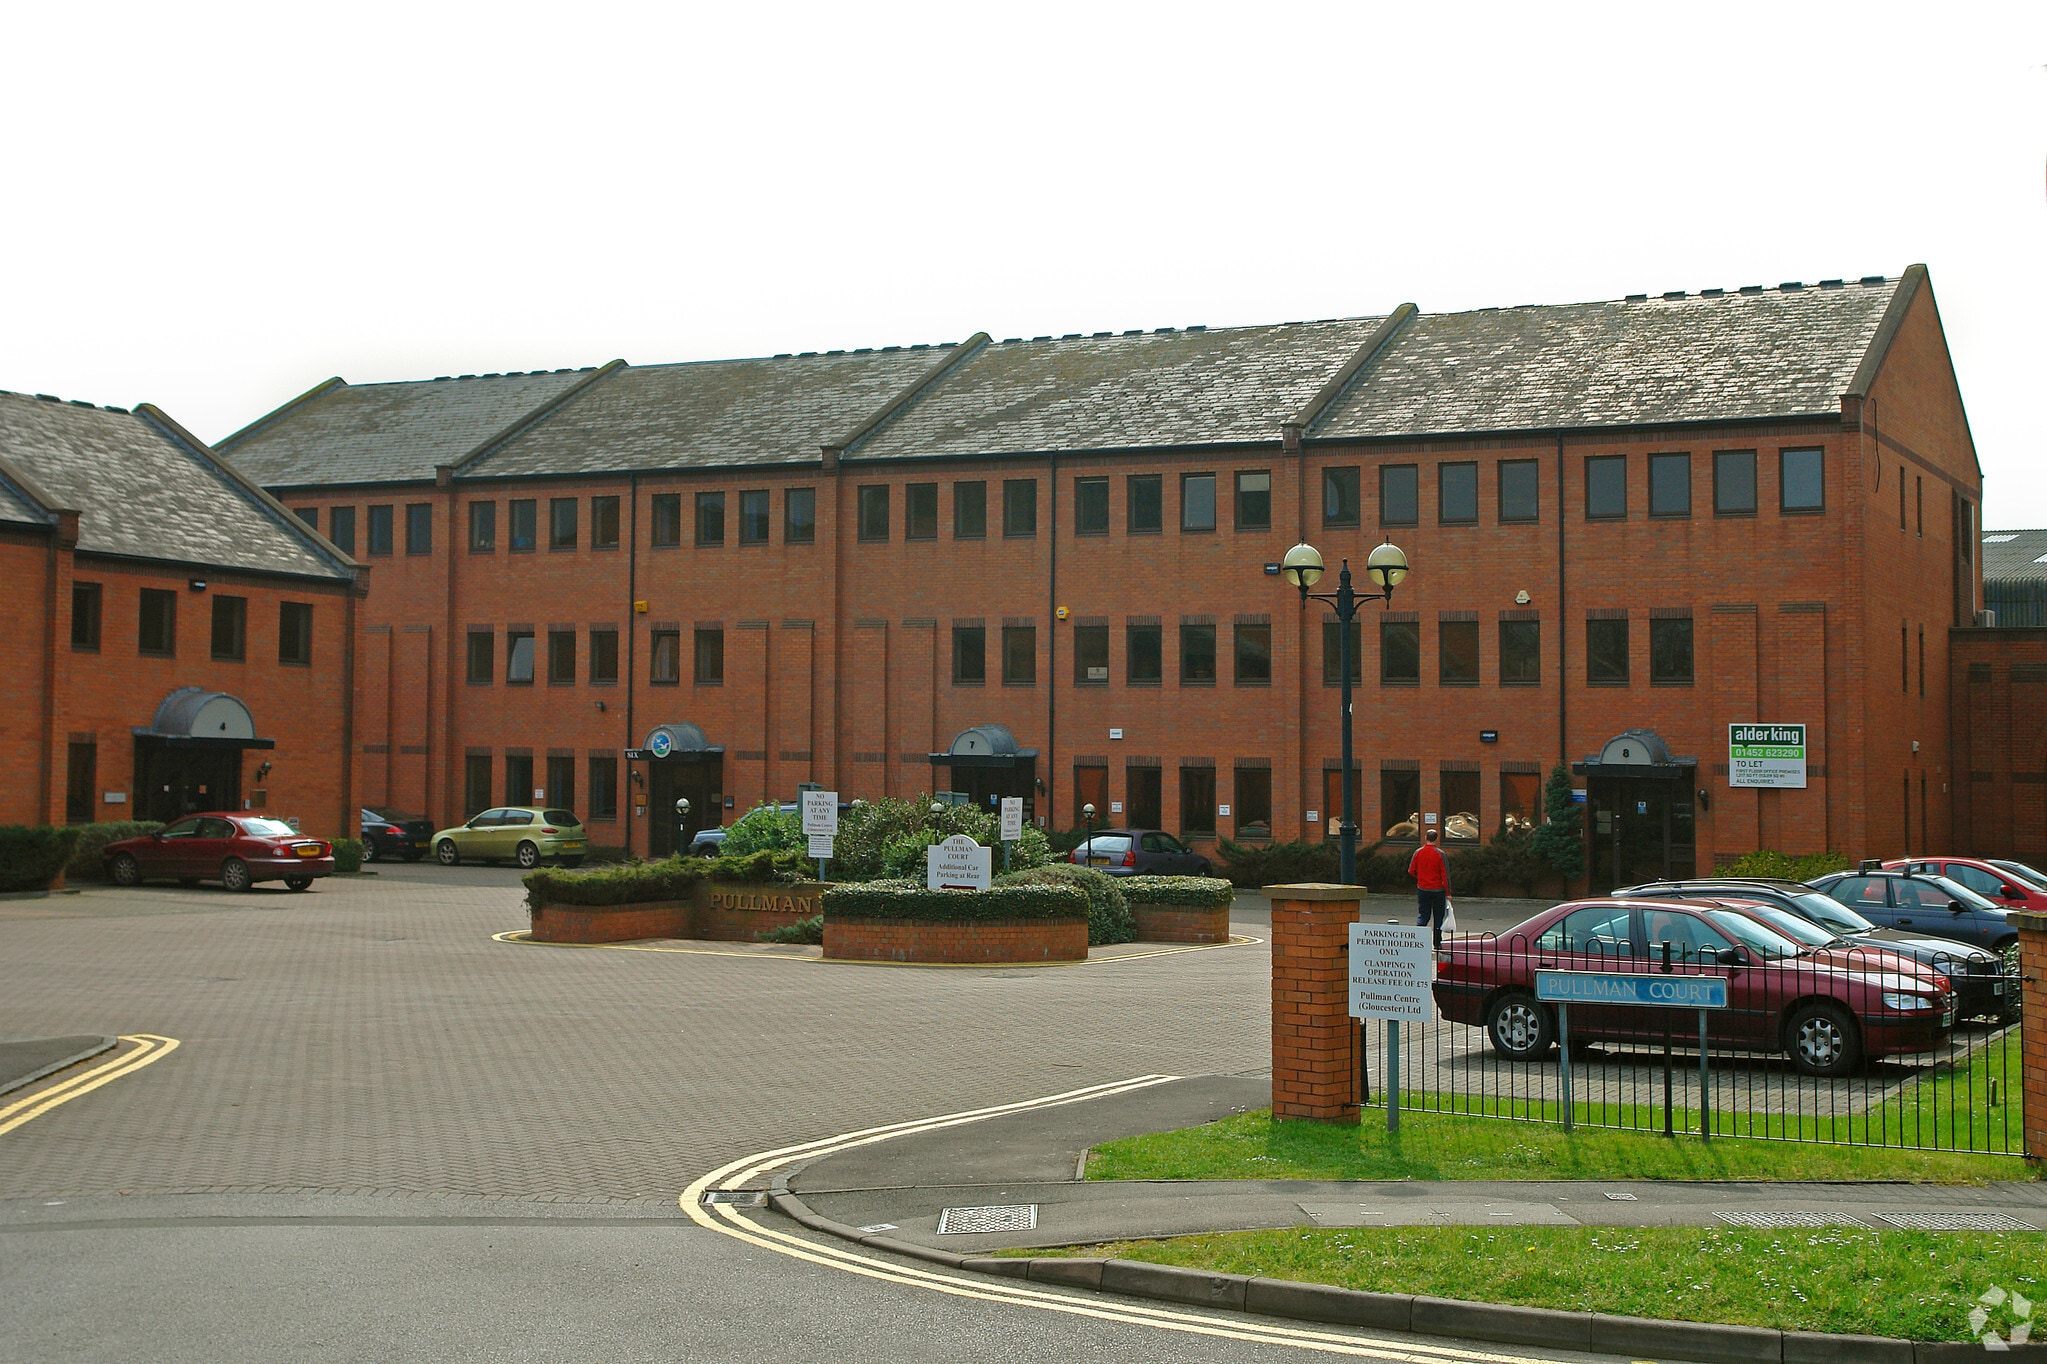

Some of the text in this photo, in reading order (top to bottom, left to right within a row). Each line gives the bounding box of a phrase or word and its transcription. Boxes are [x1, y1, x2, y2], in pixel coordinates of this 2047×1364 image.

[1736, 727, 1799, 744] alder king
[969, 741, 975, 749] 7
[1622, 748, 1630, 758] 8
[1736, 748, 1799, 757] 01452 623290
[938, 863, 967, 871] Additional
[709, 892, 813, 913] PULLMAN
[1364, 930, 1398, 939] PARKING
[1356, 938, 1424, 948] PERMIT HOLDERS
[1379, 948, 1400, 956] ONLY
[1364, 960, 1406, 969] CLAMPING
[1368, 969, 1412, 978] OPERATION
[1352, 976, 1386, 986] RELEASE
[1388, 979, 1402, 987] FEE
[1549, 978, 1714, 1000] PULLMAN COURT
[1360, 991, 1420, 1003] Pullman Centre
[1358, 1002, 1421, 1014] (Gloucester) Ltd
